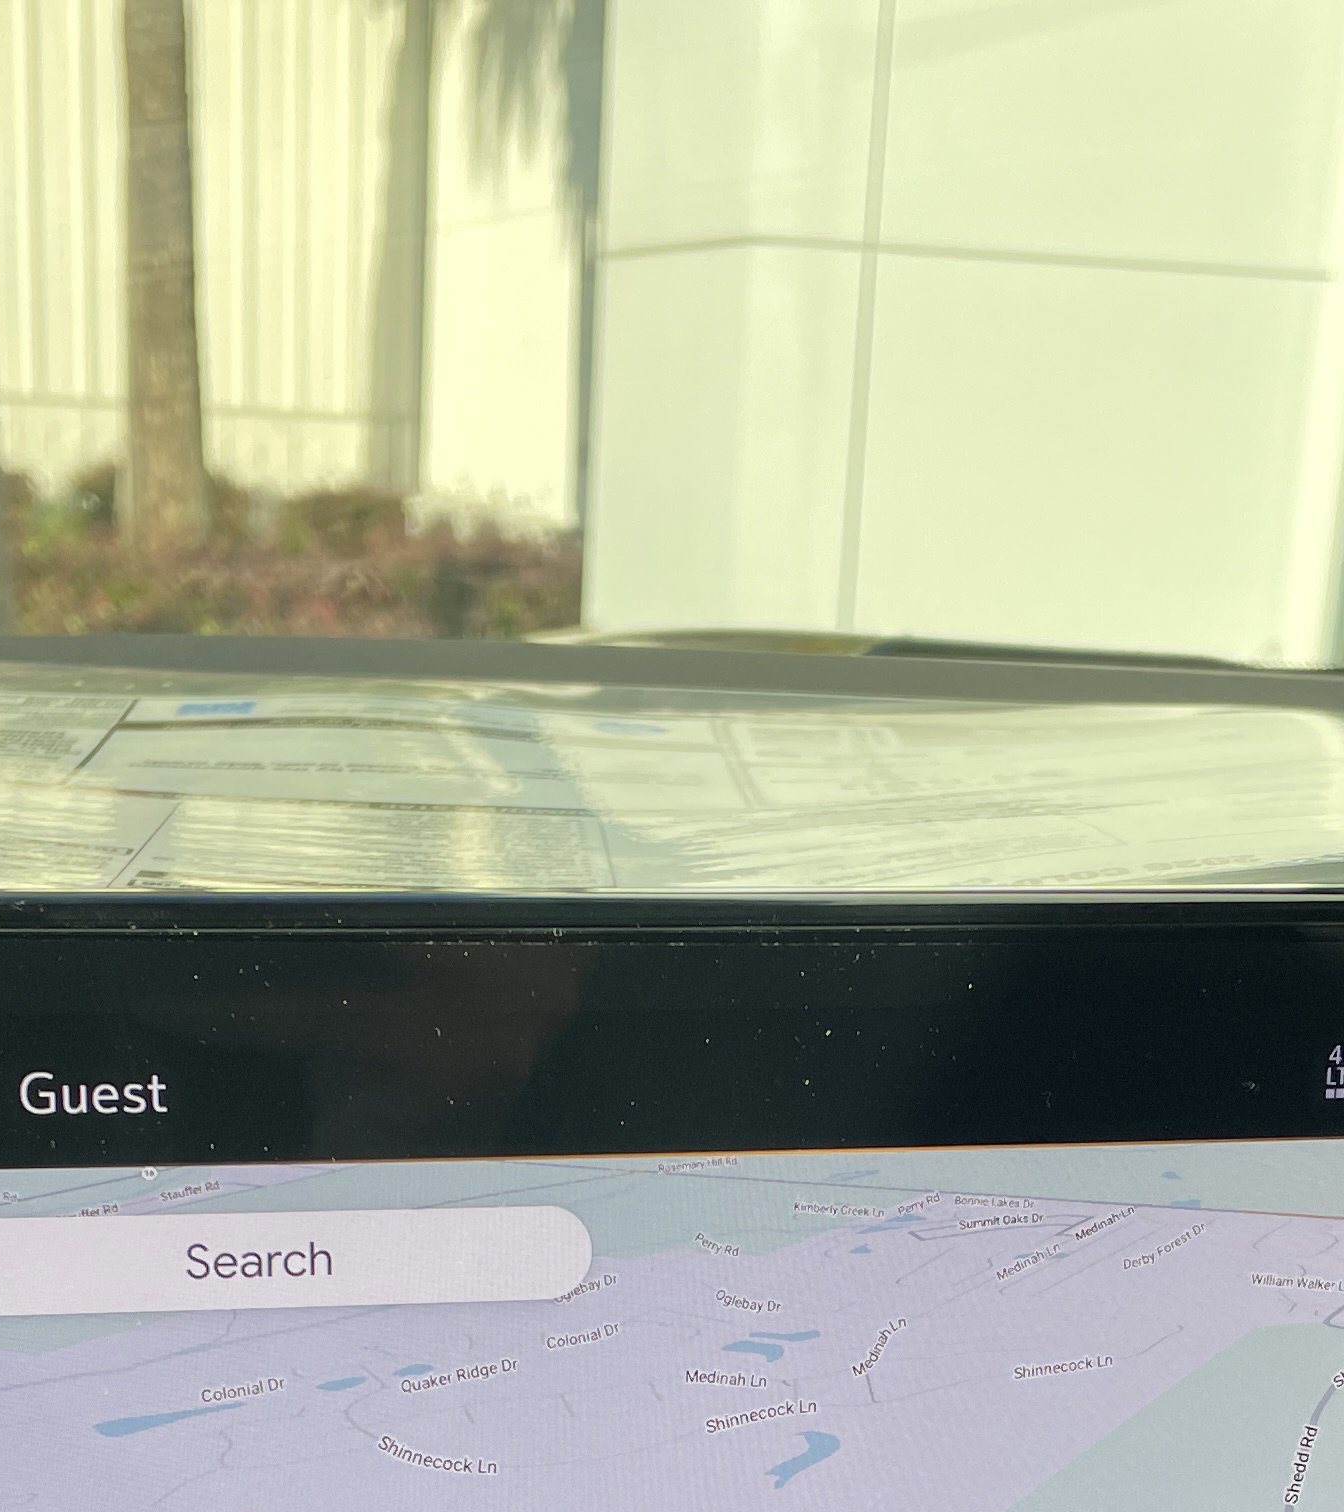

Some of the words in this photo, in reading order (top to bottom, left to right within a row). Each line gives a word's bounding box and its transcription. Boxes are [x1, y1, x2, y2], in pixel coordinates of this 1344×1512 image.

[19, 1071, 168, 1115] Guest
[725, 1156, 738, 1166] Rd
[2, 1191, 18, 1202] Rd
[205, 1180, 221, 1192] Rd
[103, 1204, 118, 1215] Rd
[839, 1204, 870, 1216] Creek
[872, 1207, 885, 1217] Ln
[897, 1200, 926, 1217] Perry
[927, 1192, 941, 1206] Rd
[954, 1196, 988, 1208] Bonnie
[991, 1197, 1019, 1209] Lakes
[1022, 1199, 1034, 1209] Dr
[959, 1217, 1000, 1231] Summit
[1003, 1215, 1028, 1227] Oaks
[1030, 1212, 1044, 1224] Dr
[1075, 1211, 1121, 1241] Medinah
[1120, 1204, 1135, 1218] Ln
[694, 1232, 722, 1255] Perry
[723, 1243, 739, 1256] Rd
[1123, 1251, 1155, 1271] Derby
[1156, 1232, 1191, 1258] Forest
[1192, 1222, 1206, 1236] Dr
[185, 1241, 333, 1280] Search
[996, 1250, 1044, 1281] Medinah
[1046, 1242, 1061, 1256] Ln
[604, 1275, 616, 1286] Dr
[1251, 1273, 1293, 1287] William
[1296, 1275, 1335, 1290] Walker
[715, 1290, 763, 1313] Oglebay
[767, 1300, 781, 1312] Dr
[546, 1327, 602, 1349] Colonial
[604, 1322, 620, 1337] Dr
[852, 1328, 893, 1377] Medinah
[889, 1318, 907, 1333] Ln
[401, 1372, 451, 1393] Quaker
[456, 1363, 498, 1383] Ridge
[501, 1358, 518, 1373] Dr
[686, 1369, 746, 1388] Medinah
[749, 1373, 767, 1388] Ln
[1014, 1358, 1093, 1379] Shinnecock
[1097, 1354, 1113, 1367] Ln
[201, 1380, 265, 1402] Colonial
[267, 1377, 284, 1392] Dr
[706, 1400, 795, 1433] Shinnecock
[799, 1400, 817, 1414] Ln
[379, 1435, 473, 1473] Shinnecock
[478, 1459, 497, 1474] Ln
[1284, 1450, 1312, 1504] Shedd
[1300, 1425, 1318, 1450] Rd
